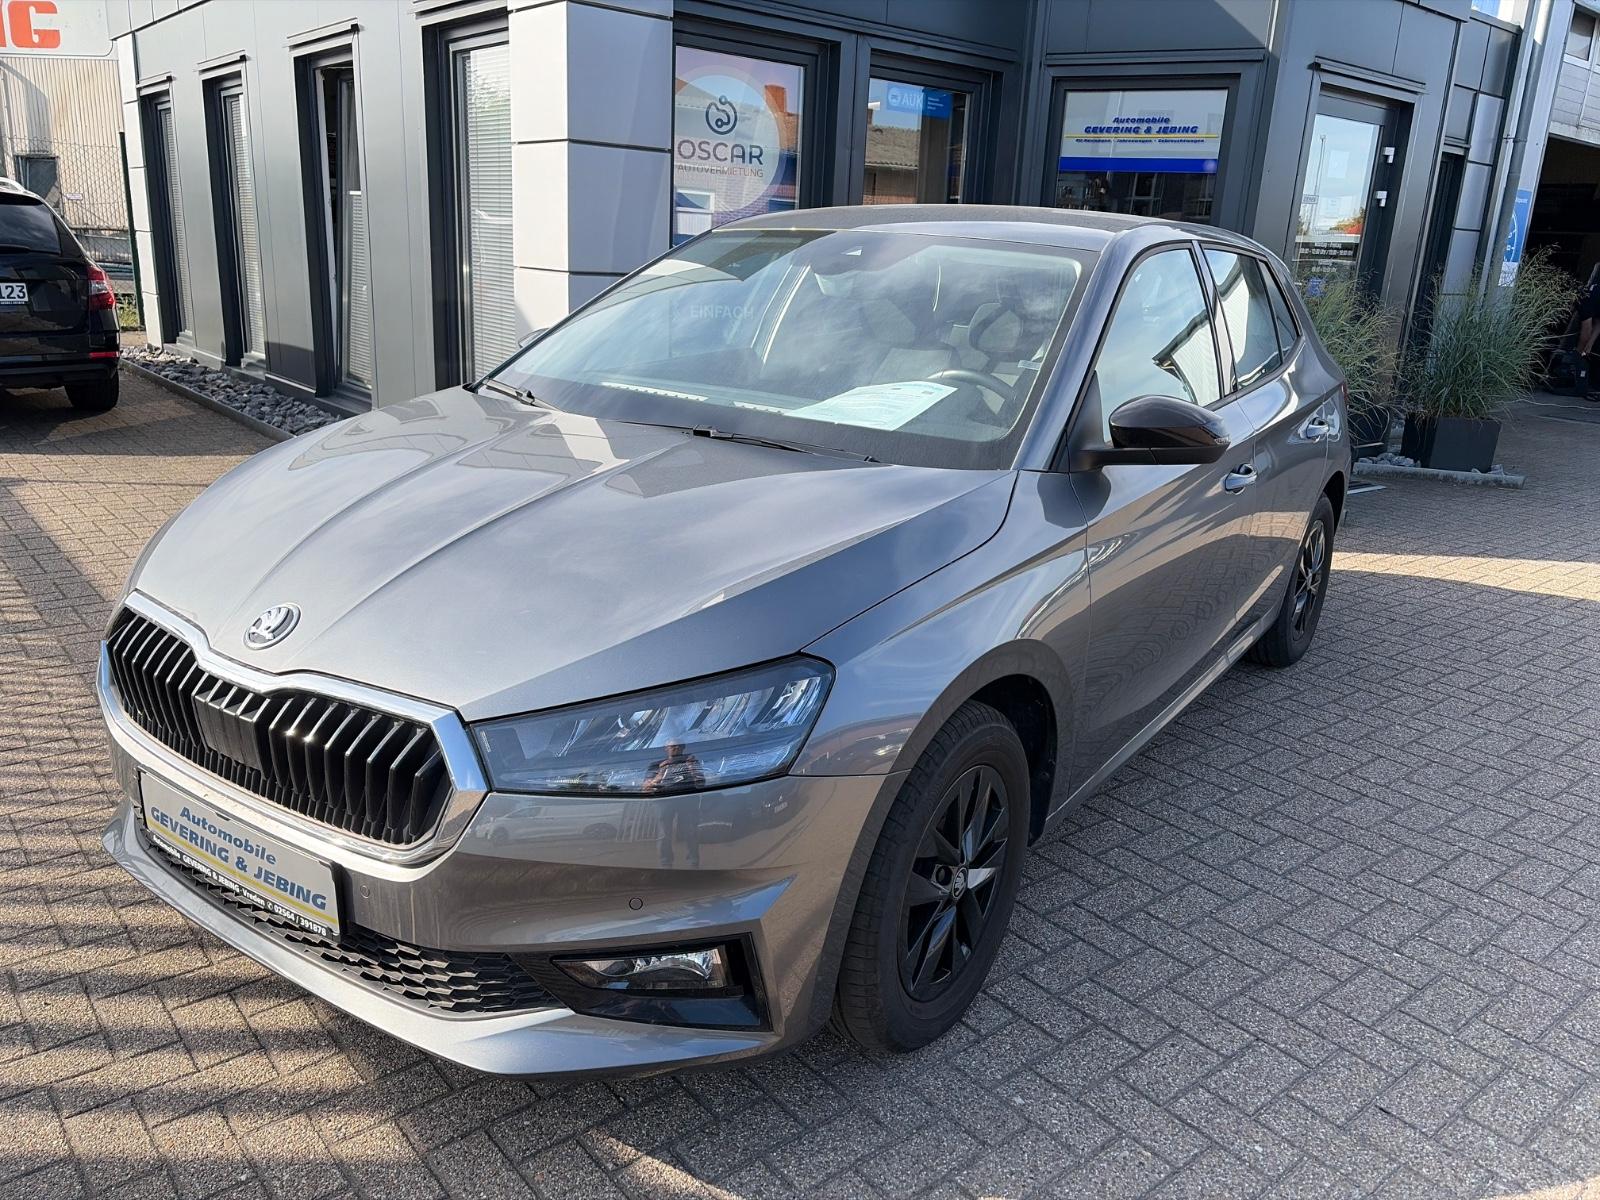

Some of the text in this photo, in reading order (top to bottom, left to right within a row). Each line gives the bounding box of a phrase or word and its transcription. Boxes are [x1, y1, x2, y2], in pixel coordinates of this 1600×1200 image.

[0, 1, 61, 49] G
[1084, 126, 1199, 134] GEVERING & JEBING
[1112, 116, 1171, 125] Automobile
[677, 139, 764, 165] OSCAR
[678, 164, 764, 178] AUTOVERMIETUNG
[690, 304, 754, 320] EINFACH
[180, 806, 277, 865] Automobile
[150, 806, 327, 911] GEVERING & JEBING
[182, 854, 212, 877] GEVERING
[243, 887, 266, 907] Vreden
[274, 904, 295, 922] 02564
[300, 917, 327, 937] 391878
